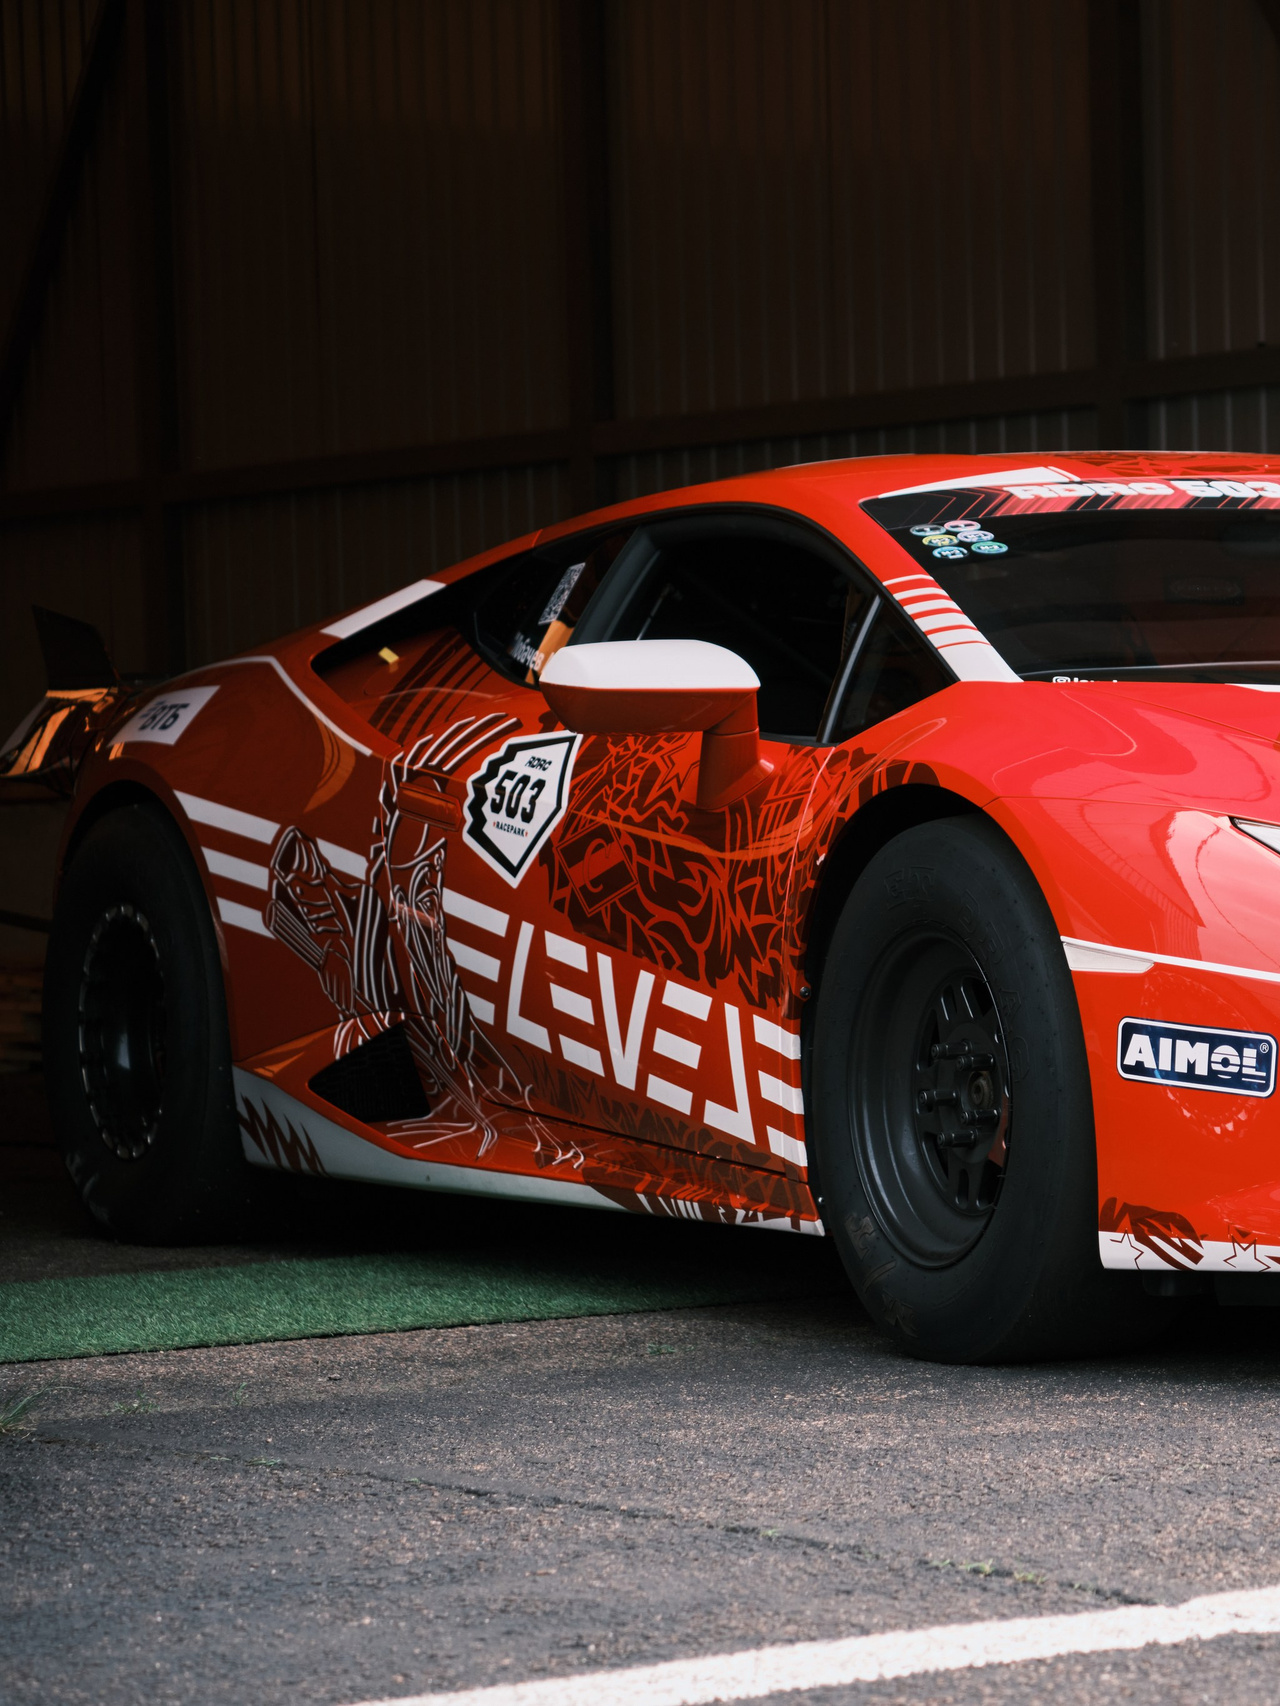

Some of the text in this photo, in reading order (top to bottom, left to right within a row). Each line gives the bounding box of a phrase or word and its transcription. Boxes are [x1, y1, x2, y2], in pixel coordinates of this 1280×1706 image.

[490, 769, 546, 824] 503
[495, 821, 525, 837] RACEPARK
[1123, 1033, 1267, 1083] AIMOL
